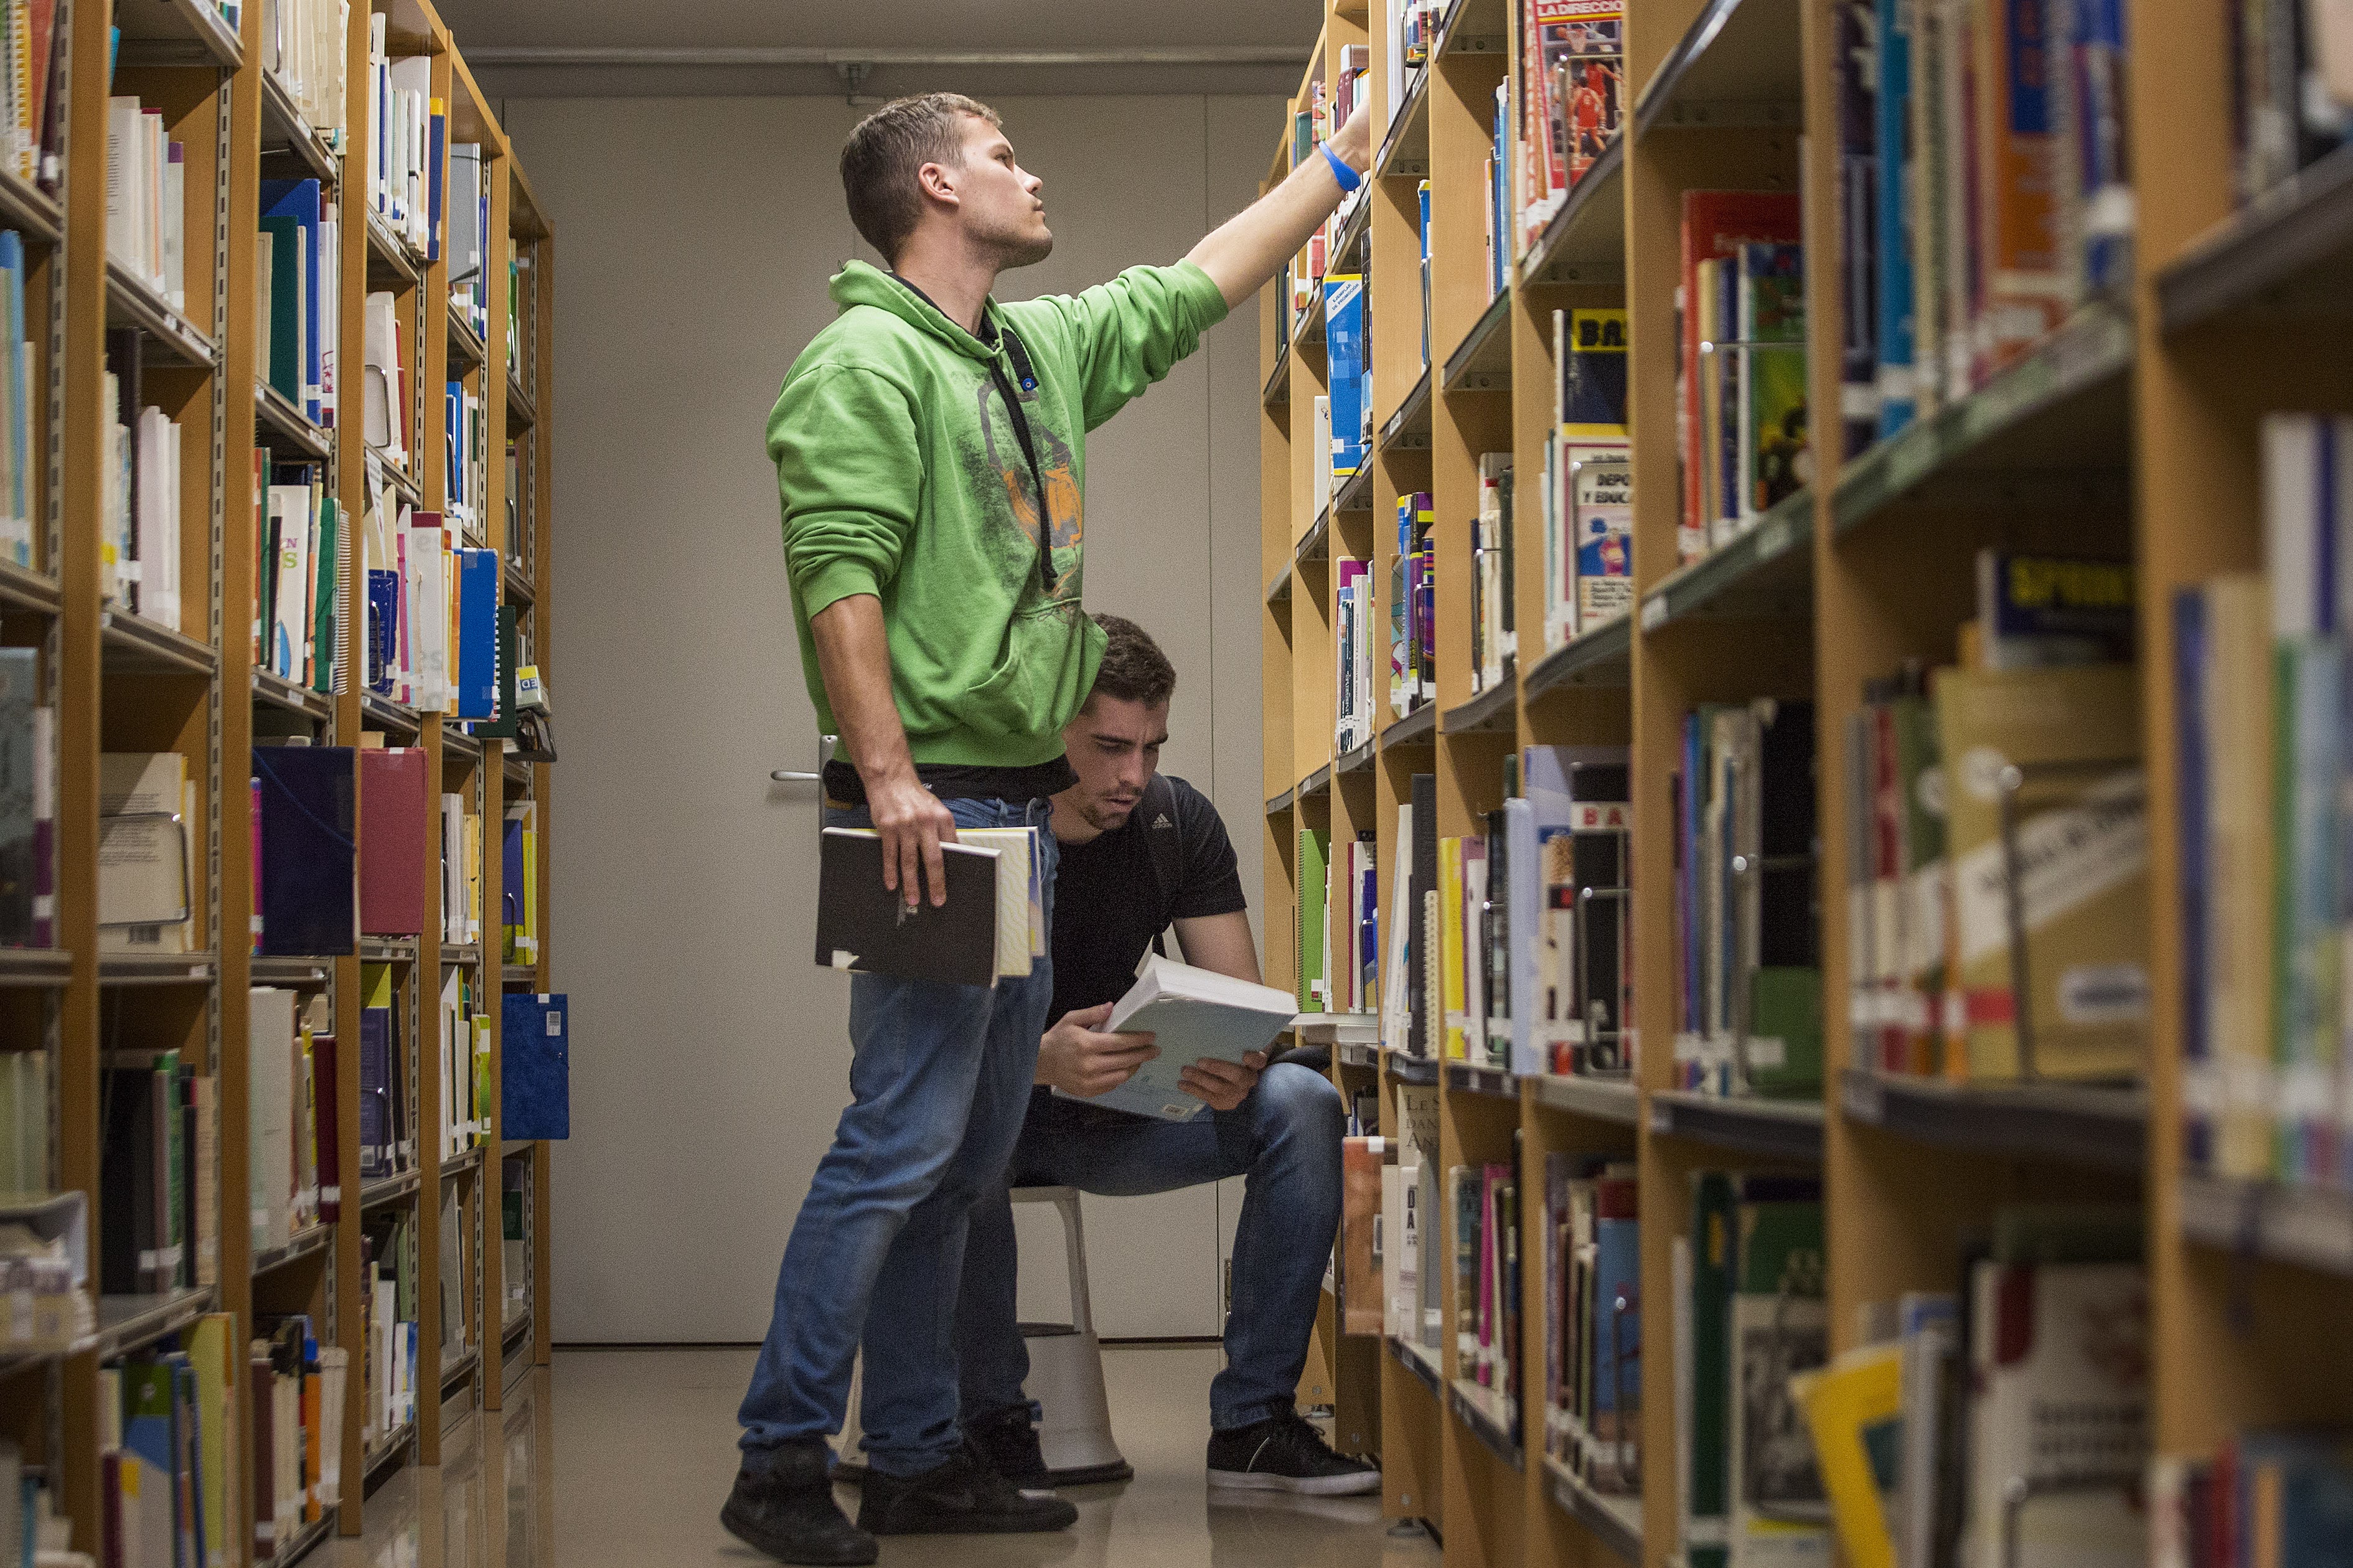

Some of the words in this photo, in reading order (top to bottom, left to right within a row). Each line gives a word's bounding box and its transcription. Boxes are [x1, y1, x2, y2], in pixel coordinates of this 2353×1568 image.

[1537, 5, 1557, 17] LA
[1333, 283, 1352, 303] EJEMPLAR
[1579, 319, 1627, 346] BA
